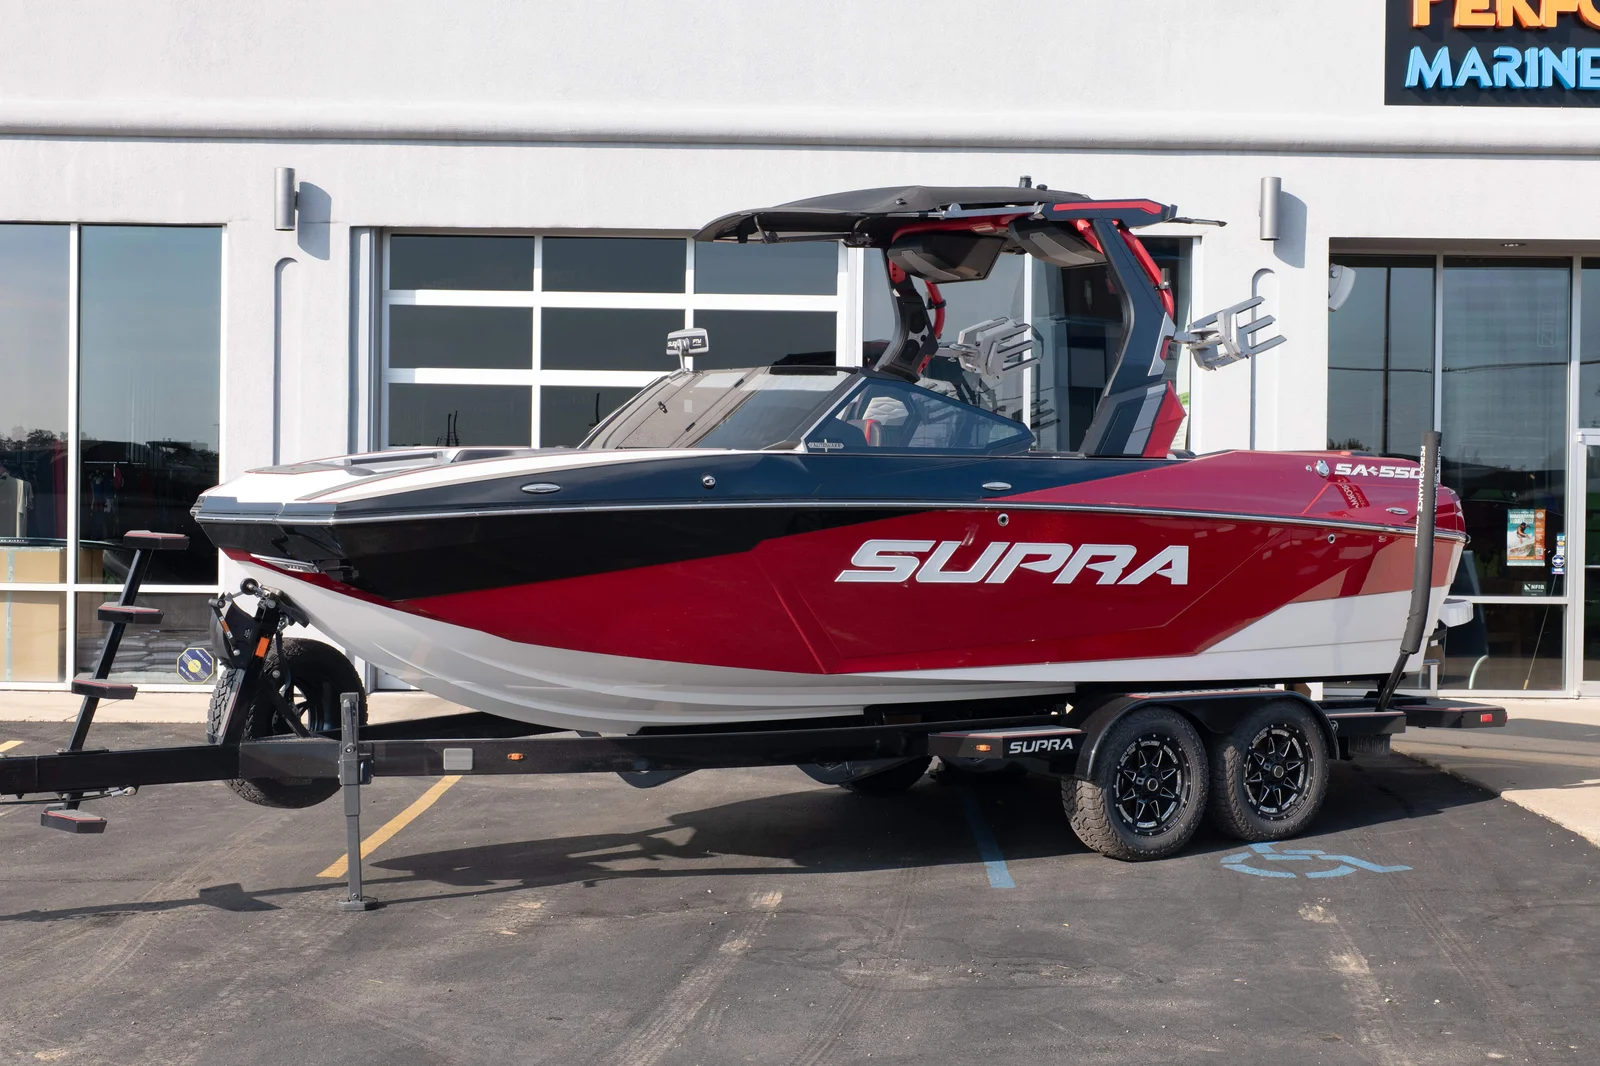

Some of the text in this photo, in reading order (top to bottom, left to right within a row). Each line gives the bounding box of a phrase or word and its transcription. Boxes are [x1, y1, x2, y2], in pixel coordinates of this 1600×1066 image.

[1404, 45, 1600, 90] MARINE
[1417, 445, 1426, 512] PERFORMANCE
[834, 539, 1189, 585] SUPRA
[1008, 737, 1074, 754] SUPRA
